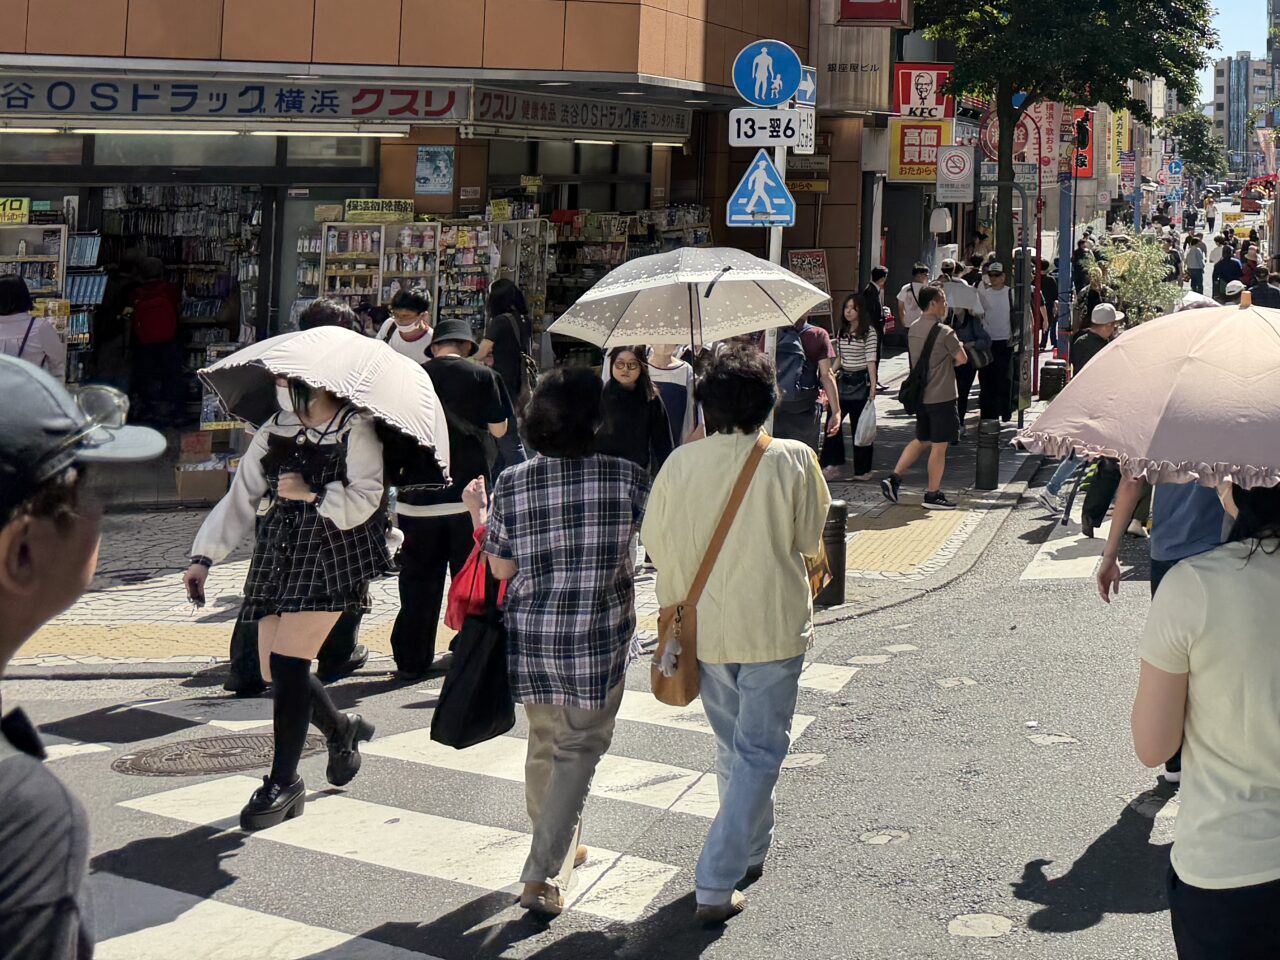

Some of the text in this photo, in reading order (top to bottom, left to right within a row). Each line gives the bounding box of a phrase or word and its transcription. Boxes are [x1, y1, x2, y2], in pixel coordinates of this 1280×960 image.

[827, 63, 880, 73] 銀座屋ビル
[1, 81, 456, 117] 谷OSドラッグ横浜 クスリ
[479, 92, 686, 130] クスリ 健康食品 渋谷OSドラッグ横浜 コンタクト用品
[908, 107, 938, 117] KFC
[735, 118, 796, 139] 13-翌6
[801, 113, 813, 130] -13
[904, 128, 938, 146] 高価
[904, 146, 937, 163] 買取
